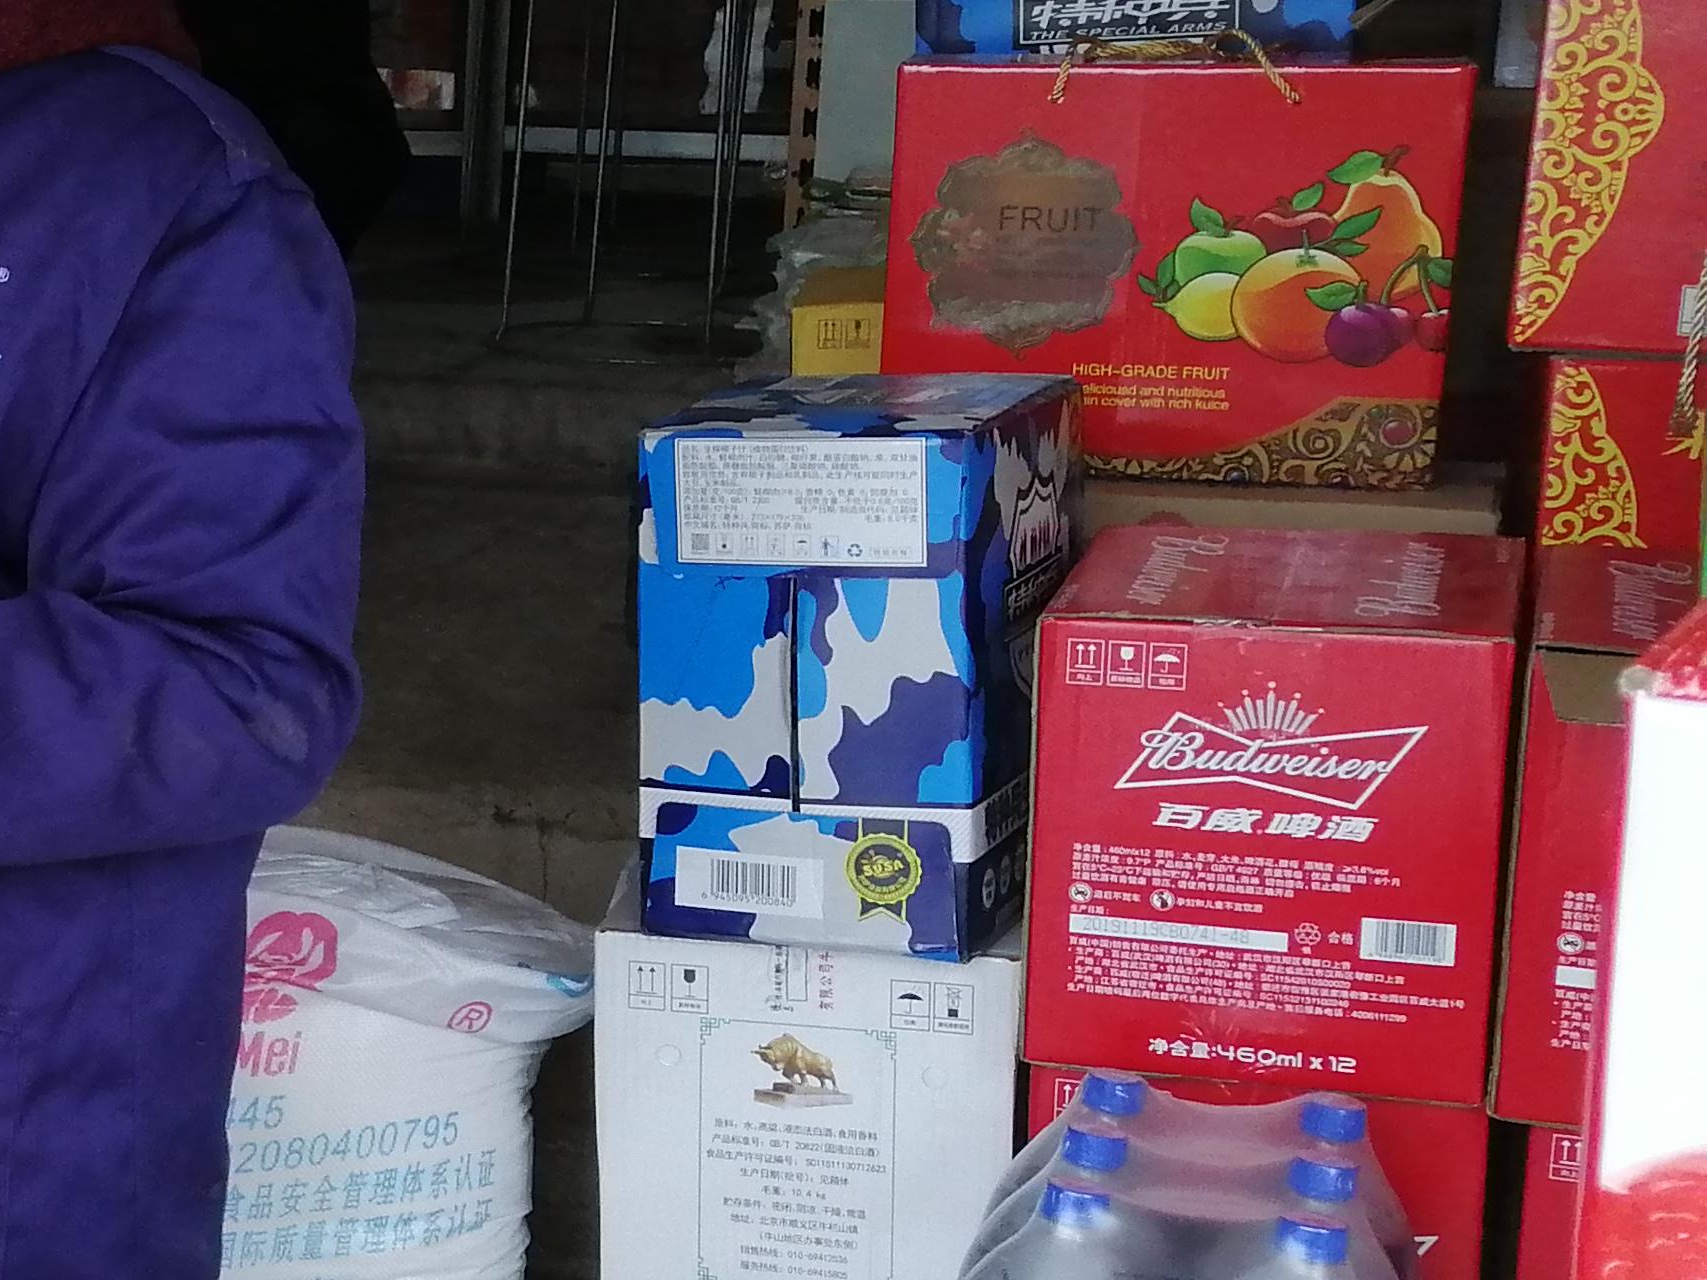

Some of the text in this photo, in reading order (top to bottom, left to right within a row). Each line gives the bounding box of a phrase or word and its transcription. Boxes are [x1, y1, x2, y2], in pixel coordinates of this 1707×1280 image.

[1029, 20, 1228, 41] THE SPECIAL ARMS
[999, 205, 1102, 233] FRUIT
[1182, 366, 1230, 380] FRUIT
[1139, 385, 1164, 396] and
[1101, 398, 1136, 407] cover
[1139, 398, 1165, 408] with
[1141, 729, 1389, 781] Budweiser
[1151, 801, 1380, 843] 百威啤酒
[862, 860, 904, 877] SUSA
[1327, 930, 1354, 946] 合格
[1327, 1057, 1356, 1074] 12
[234, 1111, 460, 1174] 2080400795
[223, 1147, 498, 1223] 食品安全管理体系认证
[221, 1198, 494, 1270] 国际质量管理体系认证
